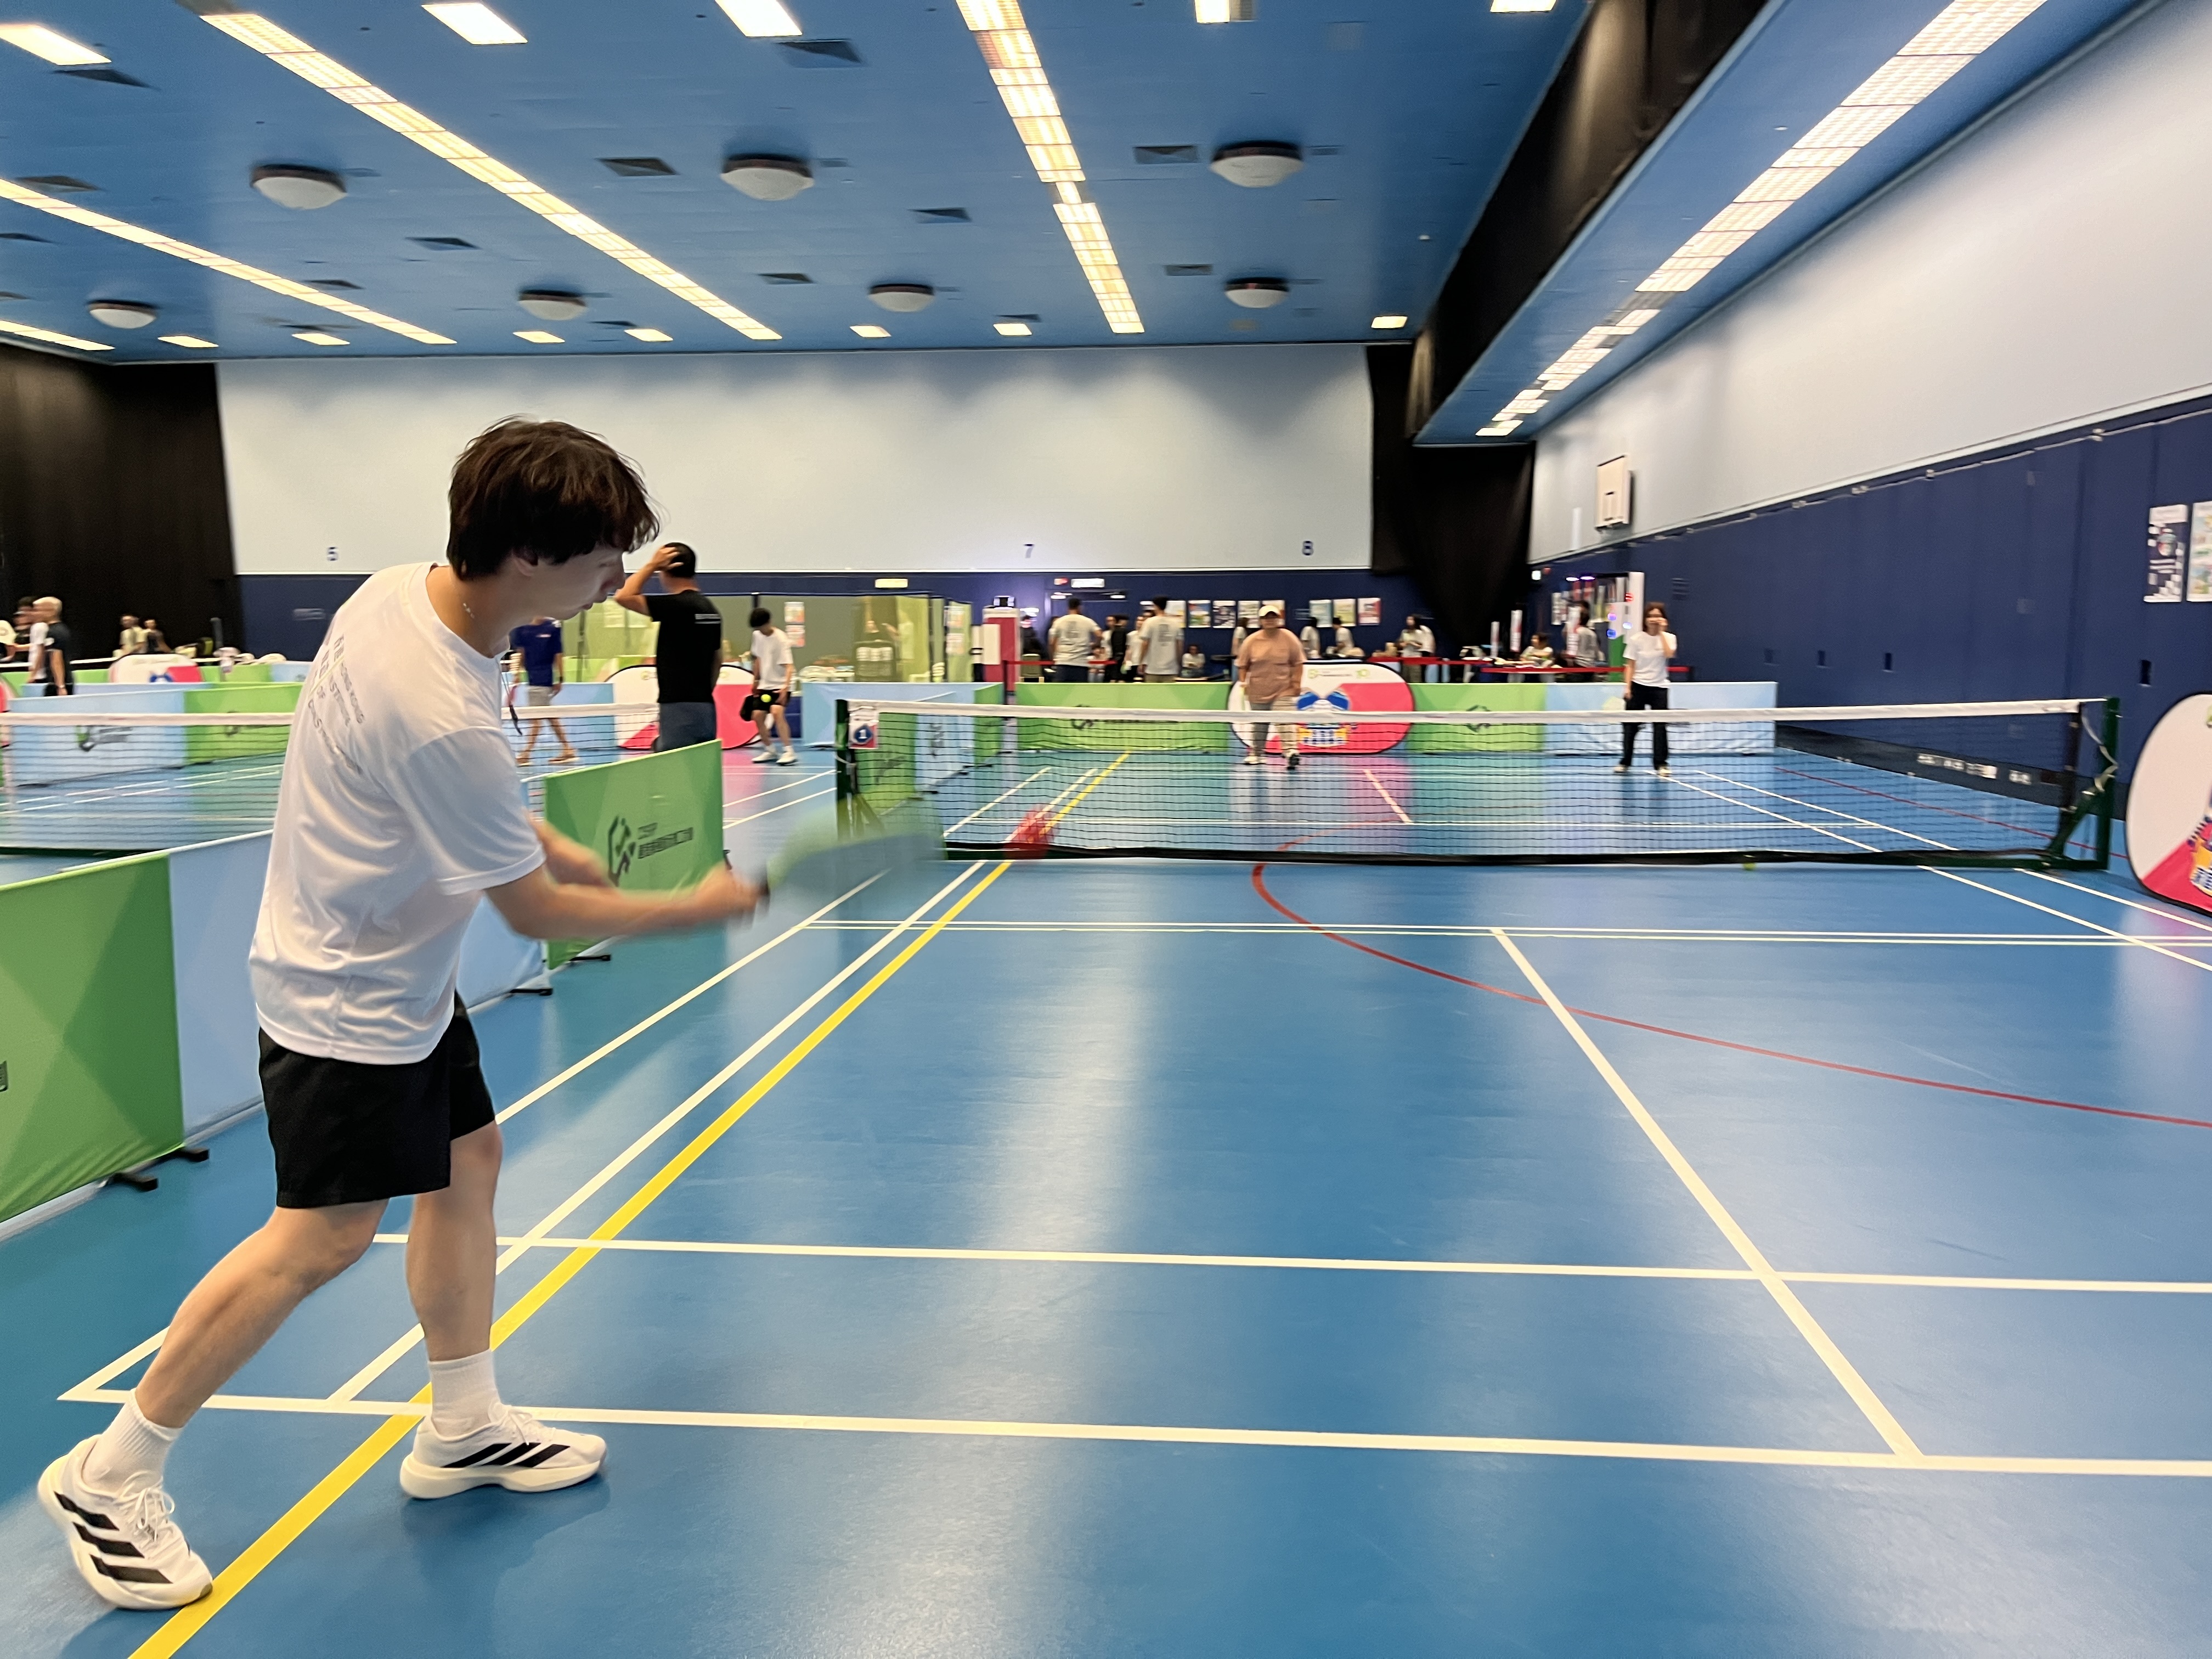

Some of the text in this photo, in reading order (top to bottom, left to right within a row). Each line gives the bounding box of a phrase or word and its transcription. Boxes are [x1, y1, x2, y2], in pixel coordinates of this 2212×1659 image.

[1023, 544, 1035, 558] 7
[1302, 540, 1314, 556] 8
[858, 729, 867, 739] 1
